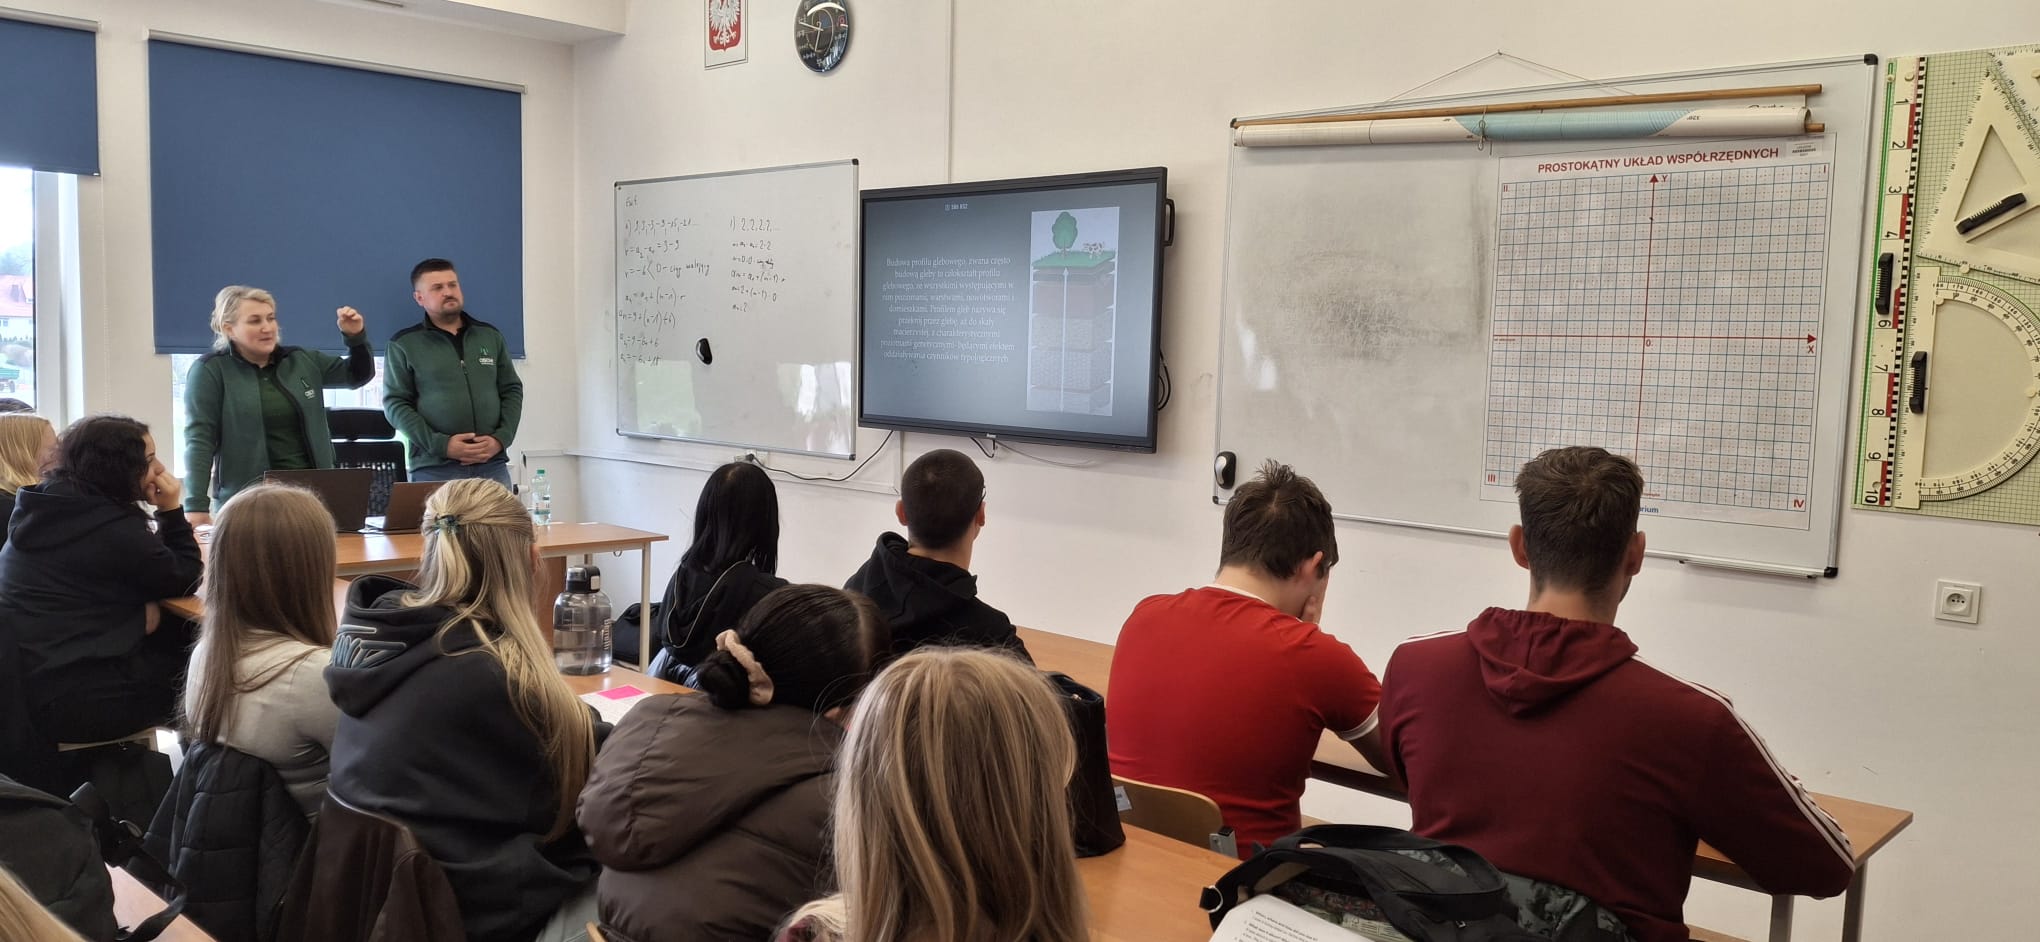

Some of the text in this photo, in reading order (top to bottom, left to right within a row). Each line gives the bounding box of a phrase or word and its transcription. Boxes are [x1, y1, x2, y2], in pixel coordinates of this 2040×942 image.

[1892, 140, 1905, 149] 2
[1537, 157, 1621, 174] PROSTOKĄTNY
[1623, 154, 1664, 168] UKŁAD
[1666, 147, 1779, 165] WSPÓŁRZĘDNYCH
[1661, 174, 1668, 183] Y
[1888, 185, 1902, 194] 3
[1885, 230, 1898, 239] 4
[911, 257, 932, 268] profilu
[1878, 319, 1891, 328] 6
[1807, 345, 1814, 354] X
[1874, 364, 1888, 372] 7
[1871, 408, 1885, 416] 8
[1868, 452, 1882, 460] 9
[1487, 474, 1496, 483] III
[1865, 488, 1879, 504] 10
[1793, 499, 1804, 508] IV
